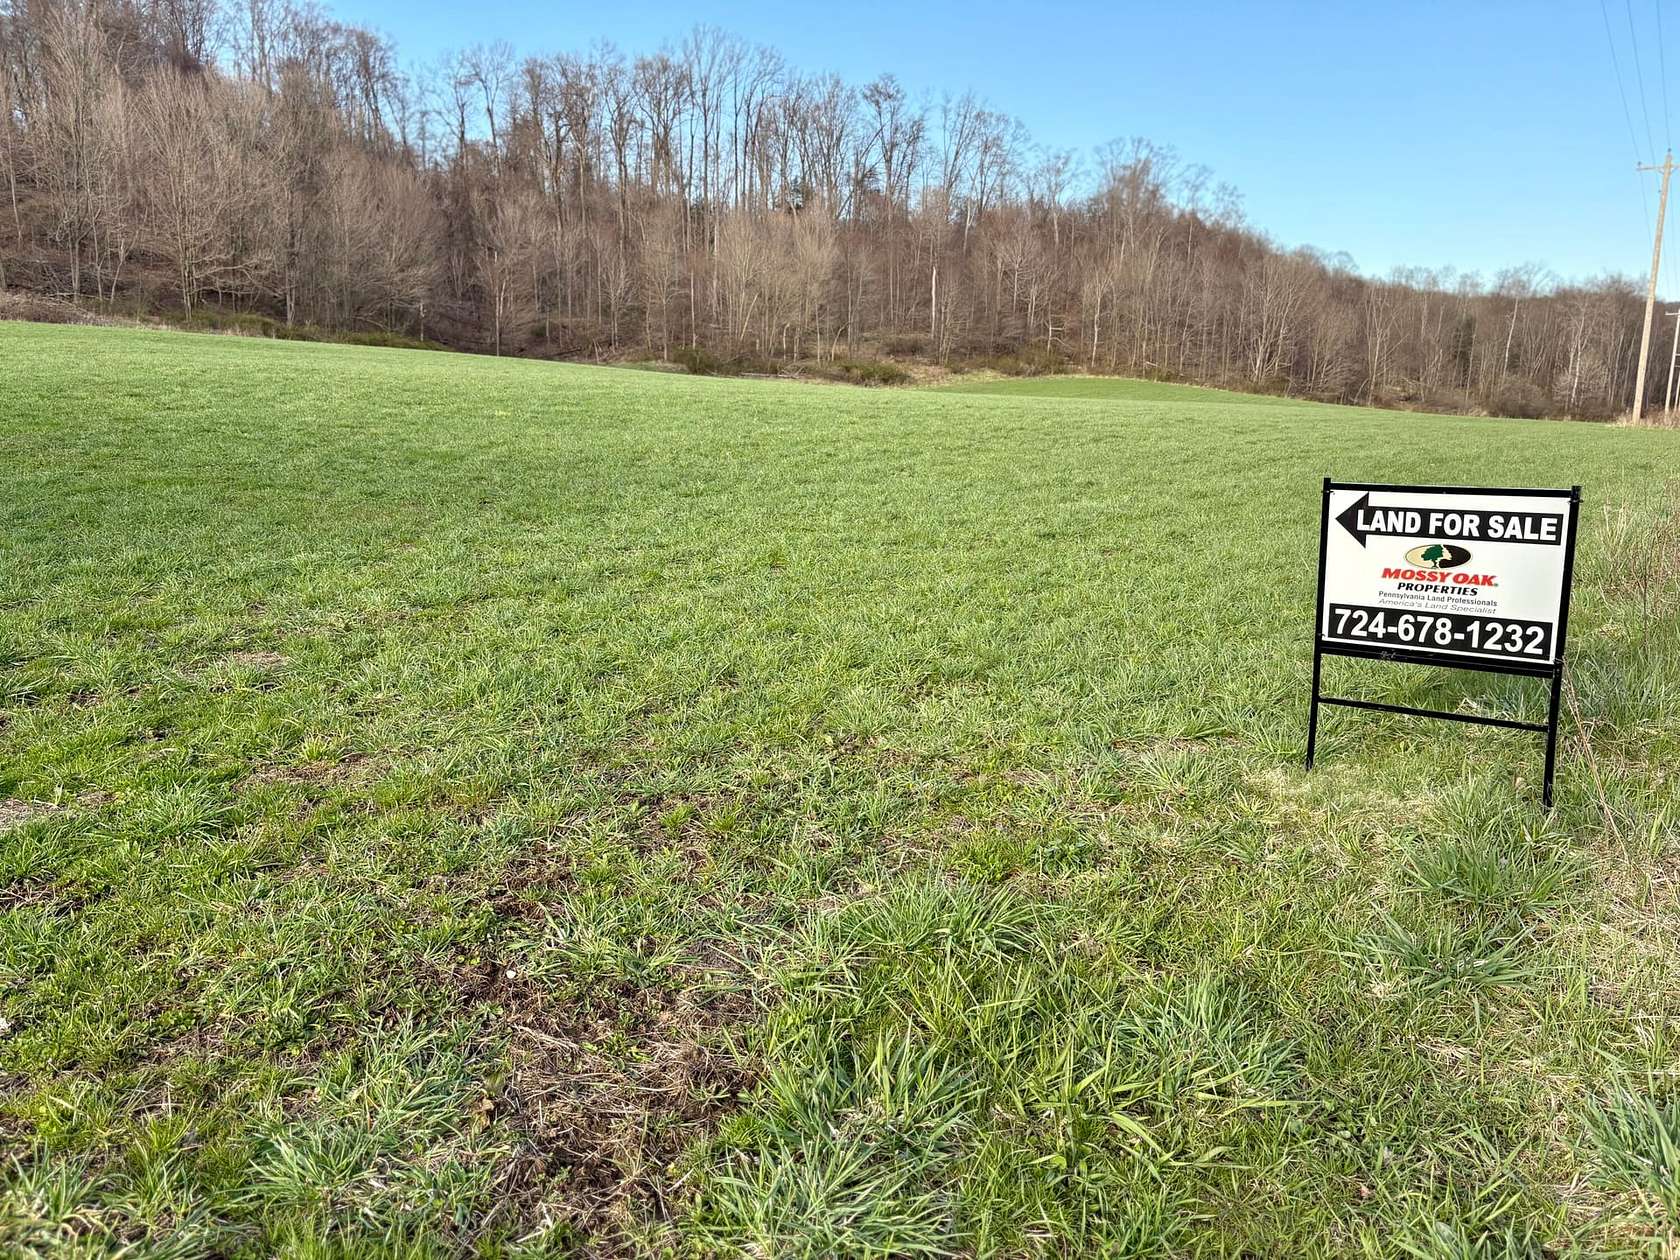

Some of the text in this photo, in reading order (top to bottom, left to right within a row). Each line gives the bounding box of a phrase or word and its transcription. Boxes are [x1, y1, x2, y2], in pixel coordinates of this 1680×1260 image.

[1356, 508, 1558, 541] LAND FOR SALE
[1381, 567, 1452, 582] MOSSY
[1397, 582, 1479, 596] PROPERTIES
[1378, 590, 1498, 607] Pennsylvania Land Professionals
[1378, 598, 1497, 615] America's Land Specialist
[1334, 608, 1545, 655] 724-678-1232
